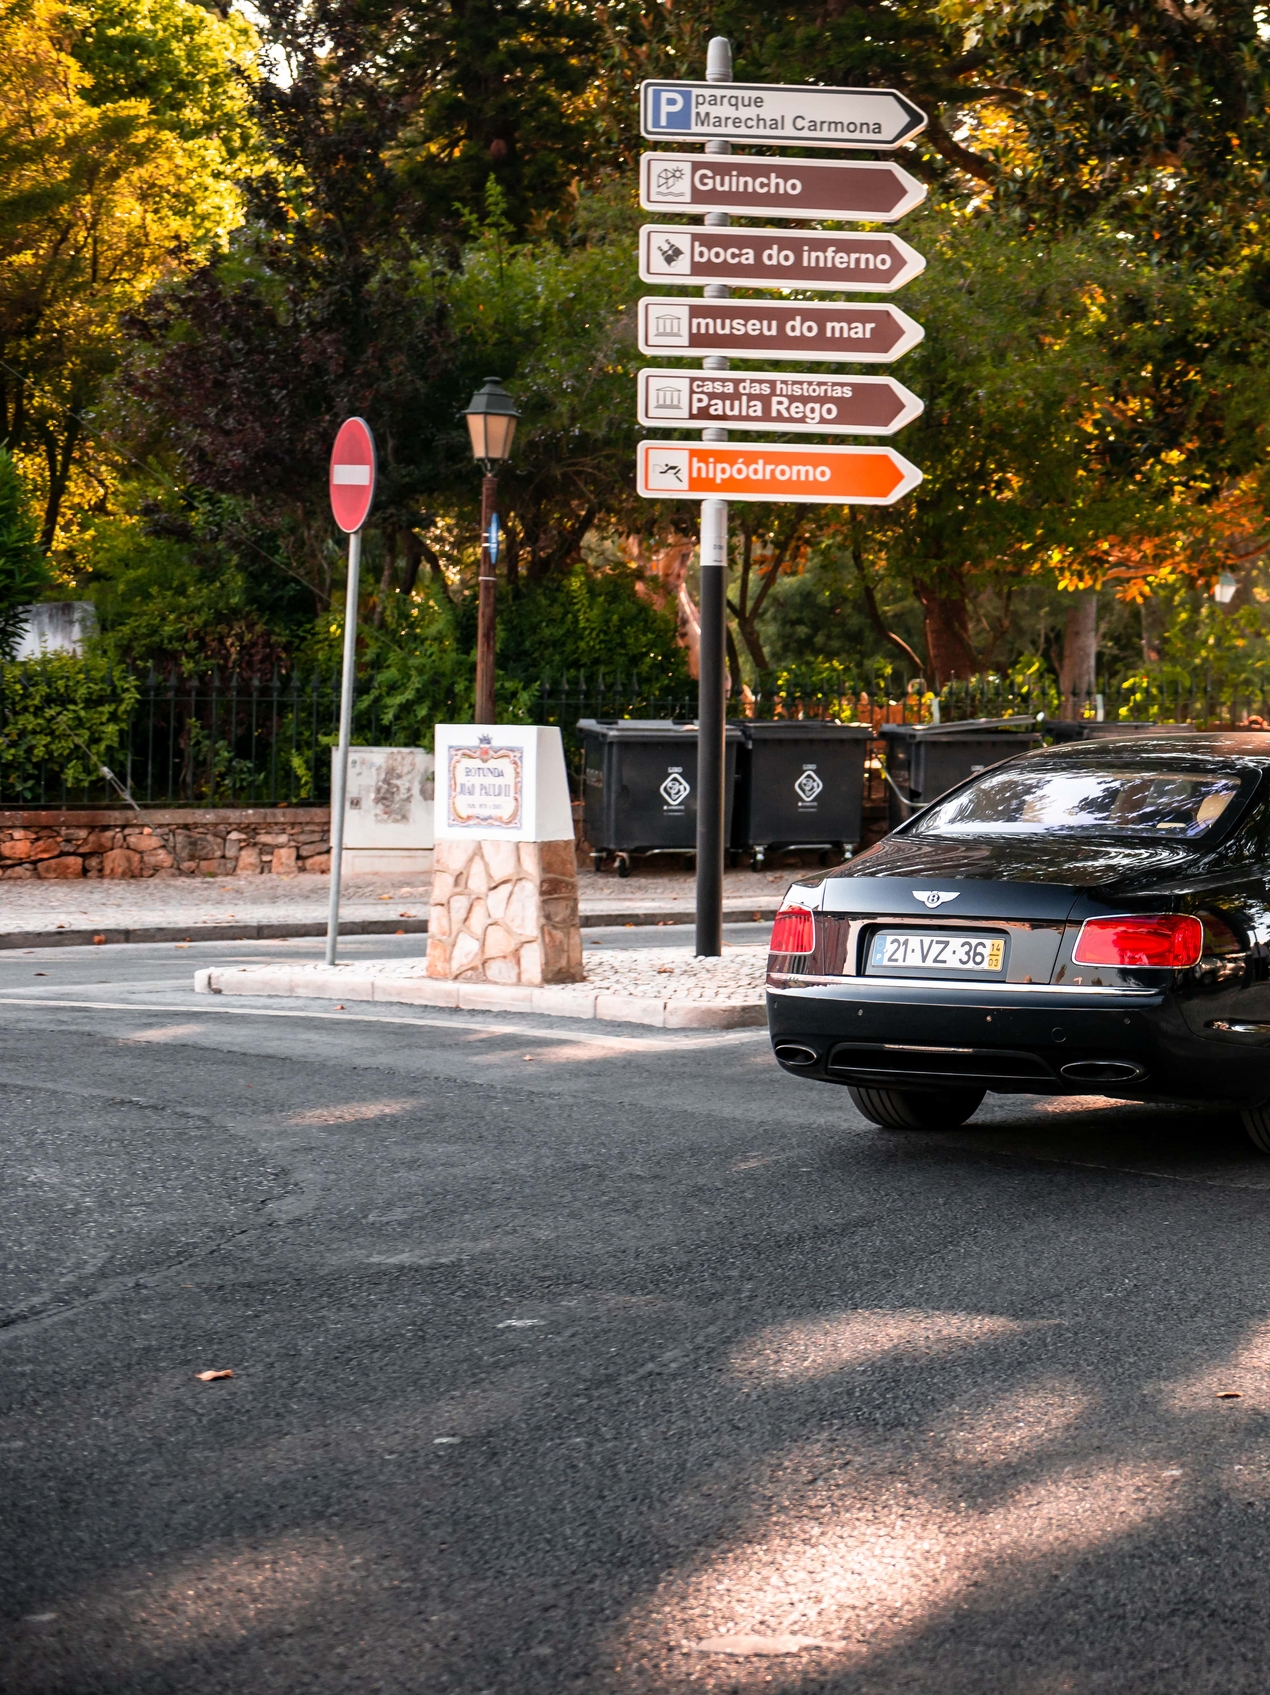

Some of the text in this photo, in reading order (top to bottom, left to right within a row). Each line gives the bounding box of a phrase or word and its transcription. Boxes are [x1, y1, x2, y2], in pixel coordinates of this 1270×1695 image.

[660, 91, 684, 126] P
[695, 92, 764, 112] parque
[694, 111, 882, 135] Marechal Carmona
[694, 169, 802, 195] Guincho
[693, 241, 892, 270] boca do inferno
[691, 316, 876, 339] museu do mar
[692, 379, 853, 398] casa das histórias
[691, 393, 838, 424] Paula Rego
[691, 457, 831, 483] hipódromo
[991, 942, 1001, 952] 14
[988, 958, 999, 967] 03
